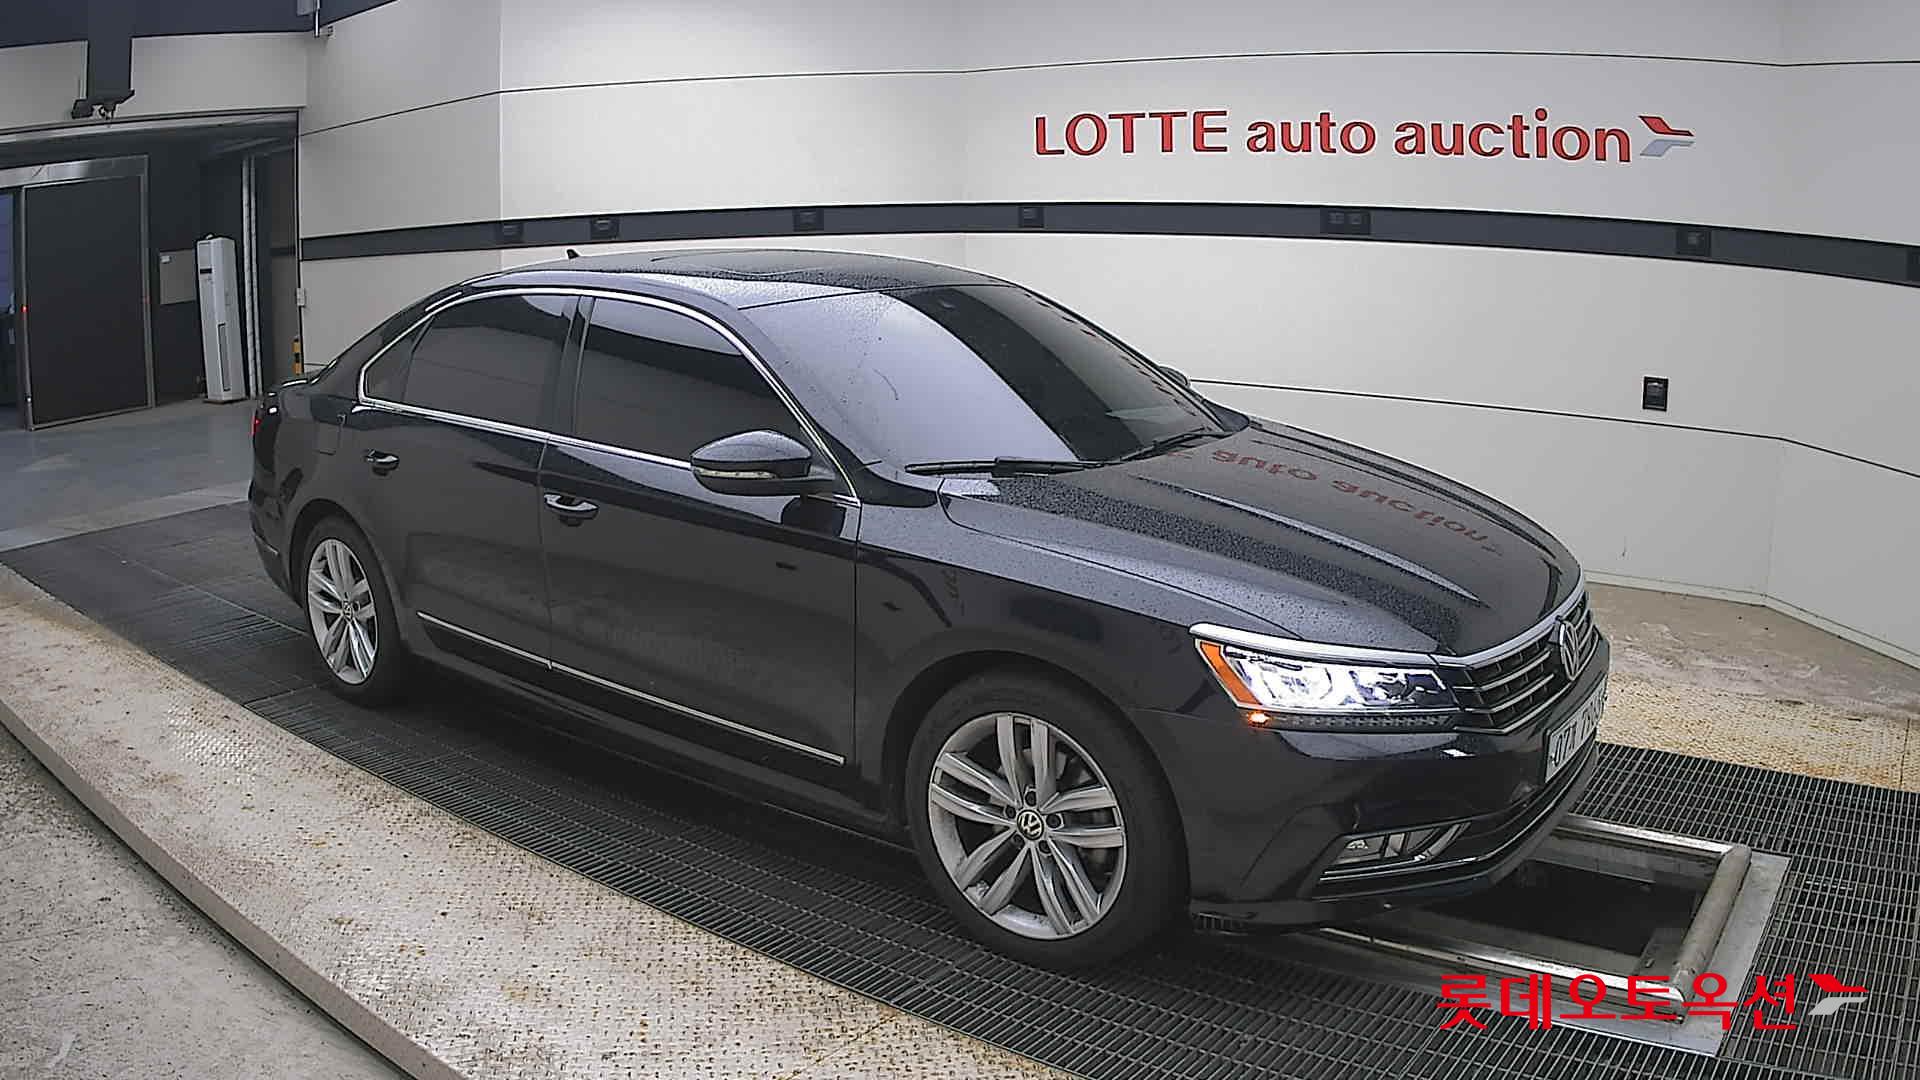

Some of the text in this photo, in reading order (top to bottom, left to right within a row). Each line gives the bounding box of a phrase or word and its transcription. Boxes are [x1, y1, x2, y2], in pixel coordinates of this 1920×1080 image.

[1035, 108, 1631, 162] LOTTE auto auction
